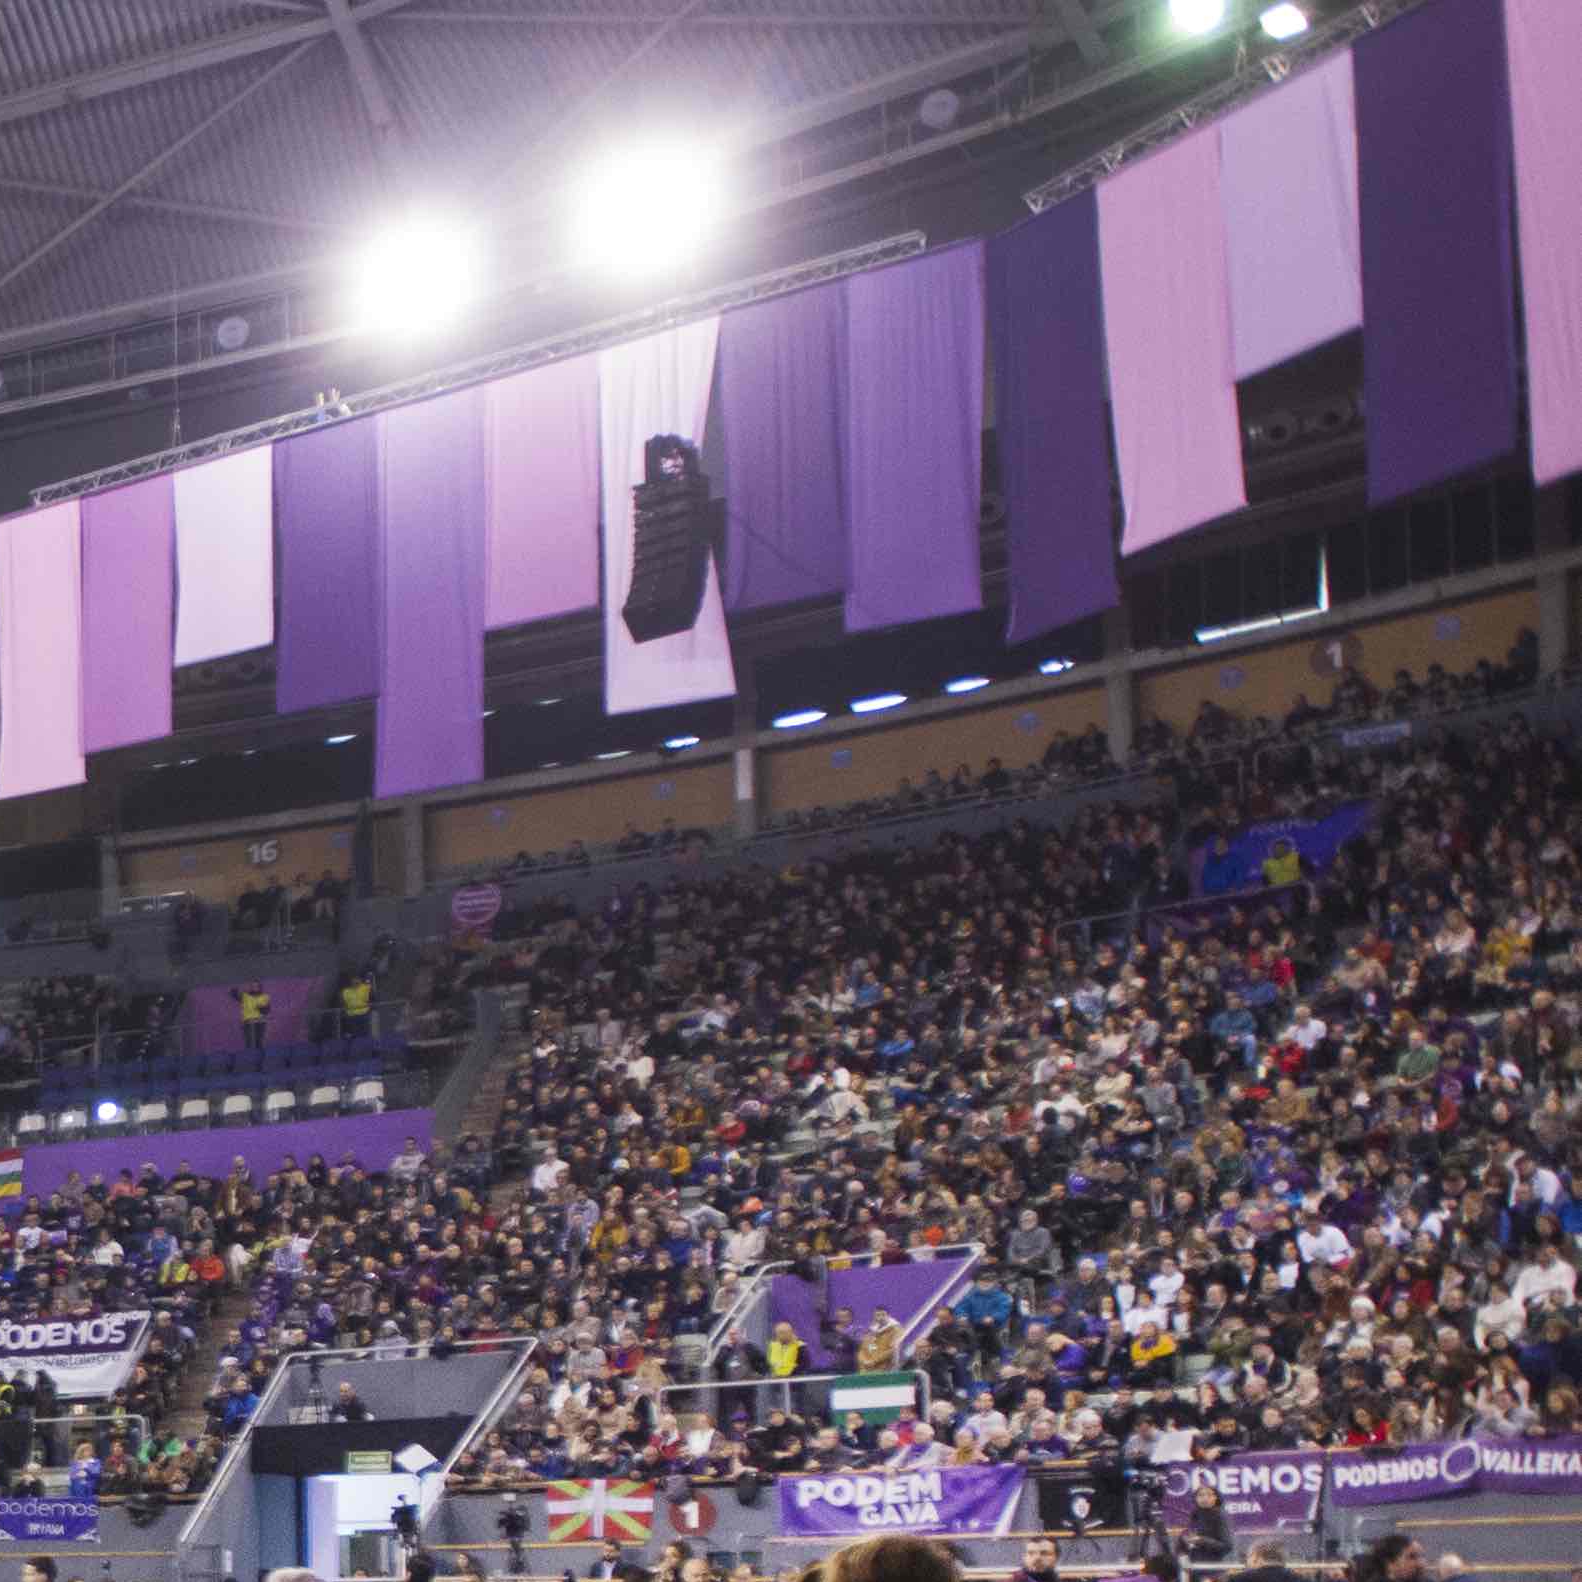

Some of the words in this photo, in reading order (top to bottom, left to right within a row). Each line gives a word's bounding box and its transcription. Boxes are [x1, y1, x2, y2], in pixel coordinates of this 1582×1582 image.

[1325, 641, 1342, 668] 1
[246, 839, 279, 864] 16
[1164, 1464, 1323, 1496] ODEMOS
[1335, 1456, 1438, 1488] PODEMOS
[796, 1471, 943, 1508] PODEM
[679, 1501, 700, 1529] 1
